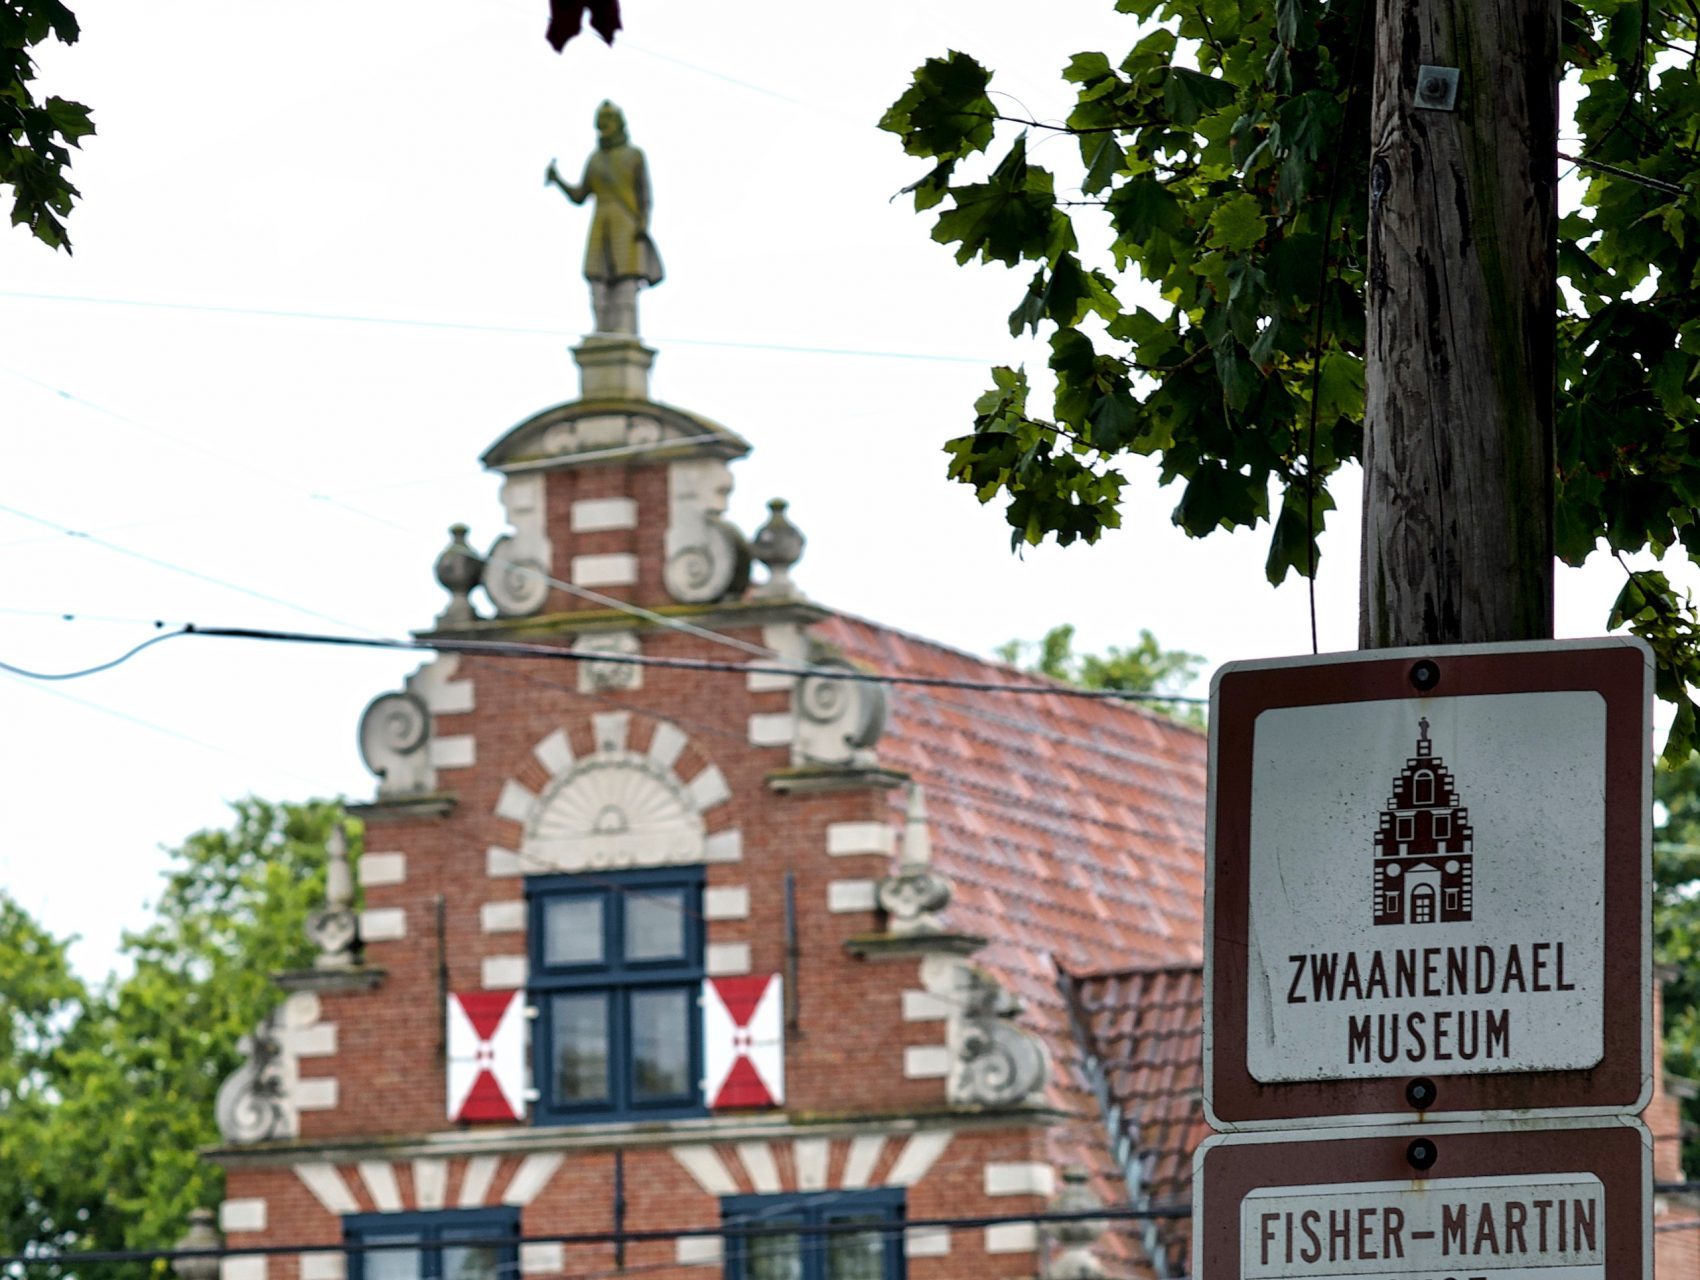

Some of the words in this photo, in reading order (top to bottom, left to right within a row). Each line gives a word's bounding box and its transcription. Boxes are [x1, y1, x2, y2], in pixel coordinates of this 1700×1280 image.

[1287, 942, 1575, 1004] ZWAANENDAEL
[1347, 1008, 1510, 1064] MUSEUM
[1260, 1198, 1597, 1265] FISHER-MARTIN
